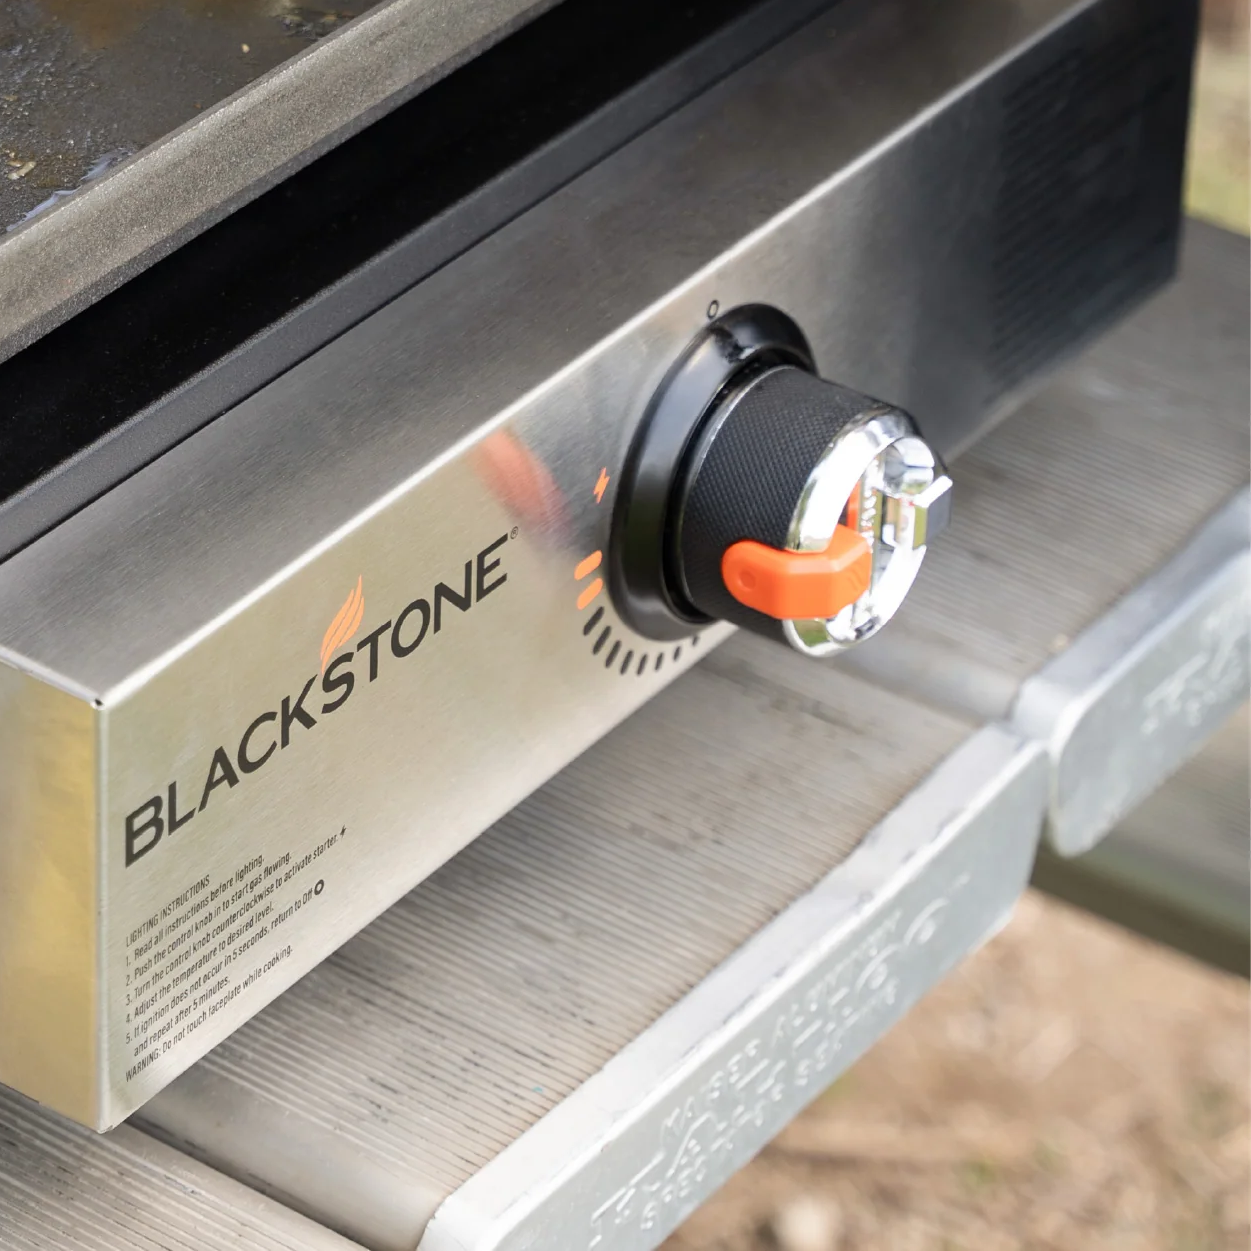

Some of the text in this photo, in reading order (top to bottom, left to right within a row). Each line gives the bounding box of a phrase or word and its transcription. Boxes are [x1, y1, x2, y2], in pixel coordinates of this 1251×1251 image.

[126, 874, 210, 947] LIGHTING INSTRUCTIONS
[126, 854, 265, 967] 1. Read all instructions before lighting.
[126, 852, 292, 987] 2. Push the control knob in to start gas flowing.
[126, 834, 338, 1006] 3. Turn the control knob counterclockwise to activate starter.
[126, 901, 274, 1023] 4. Adjust the temperature to desired level.
[126, 1032, 132, 1045] 5.
[141, 1003, 170, 1034] ignition
[170, 989, 188, 1009] does
[190, 977, 202, 994] not
[203, 961, 223, 984] occur
[224, 954, 232, 967] in
[232, 948, 238, 961] 5
[238, 925, 270, 956] seconds,
[270, 905, 294, 930] return
[294, 899, 302, 911] to
[302, 887, 313, 905] Off
[125, 945, 293, 1082] WARNING: Do not touch faceplate while cooking.
[134, 976, 230, 1056] and repeat after 5 minutes.
